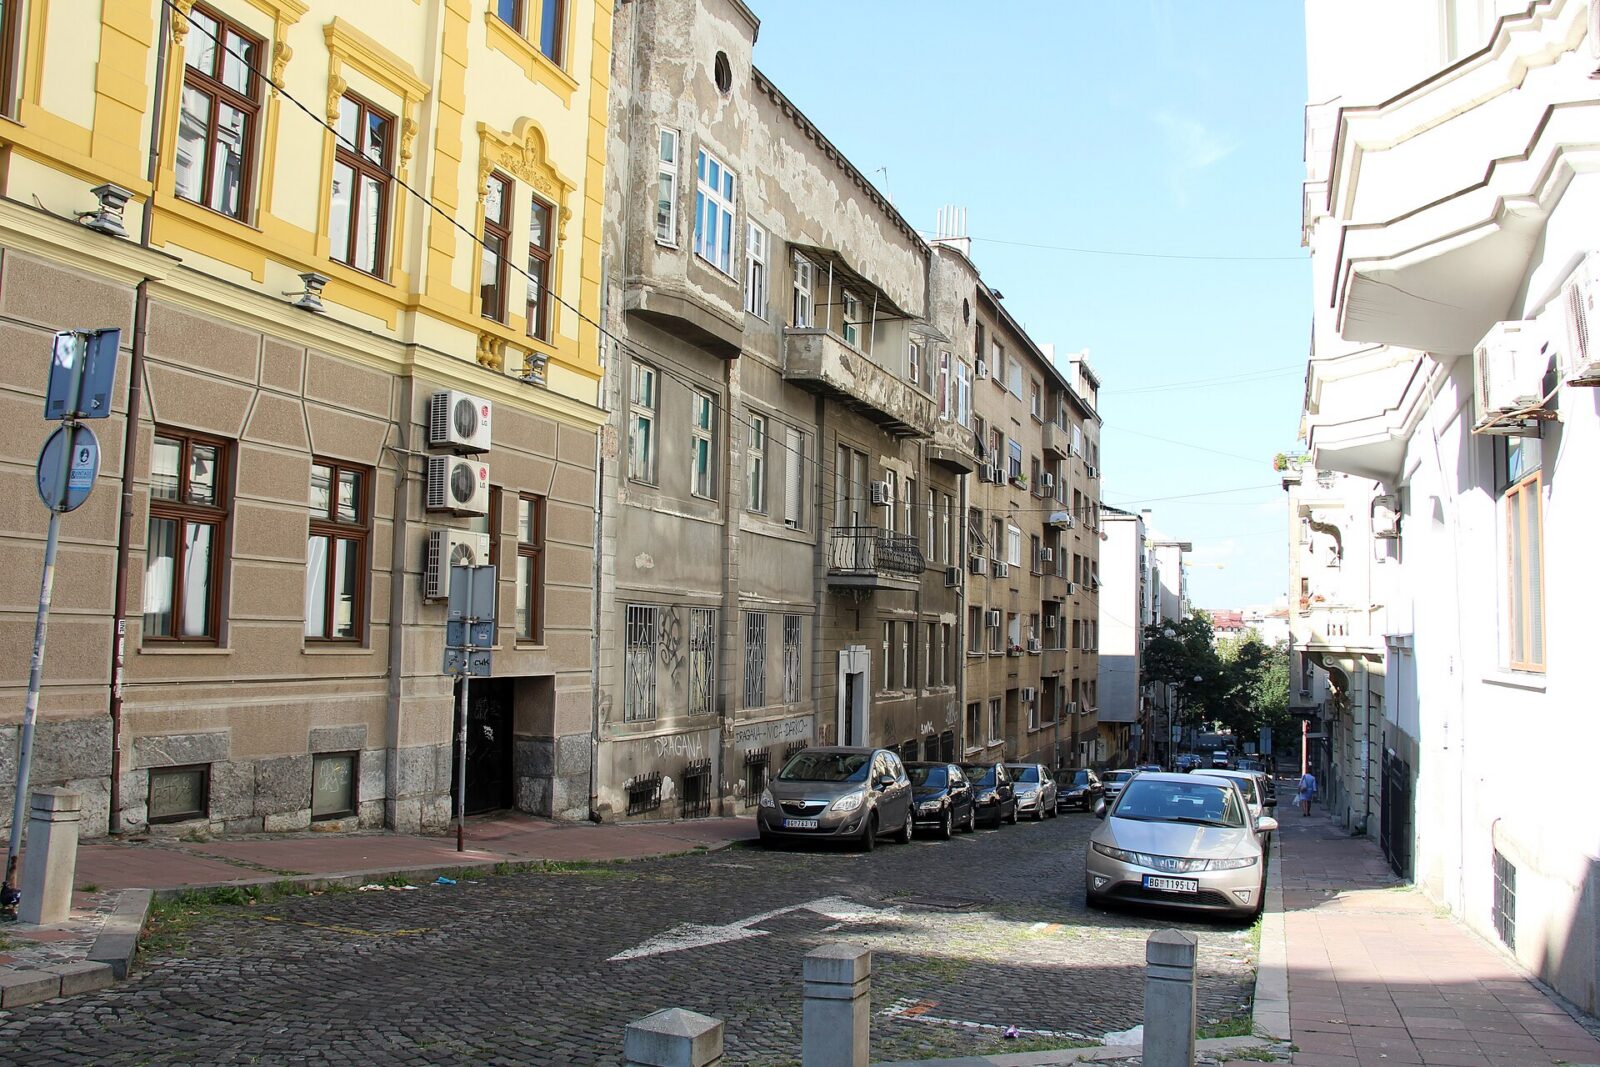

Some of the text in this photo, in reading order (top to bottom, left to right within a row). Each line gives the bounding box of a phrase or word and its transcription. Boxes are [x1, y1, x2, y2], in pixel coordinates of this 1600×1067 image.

[481, 419, 488, 427] LG
[479, 481, 486, 489] LG
[654, 731, 704, 758] DRAGANA
[1149, 878, 1159, 887] BG
